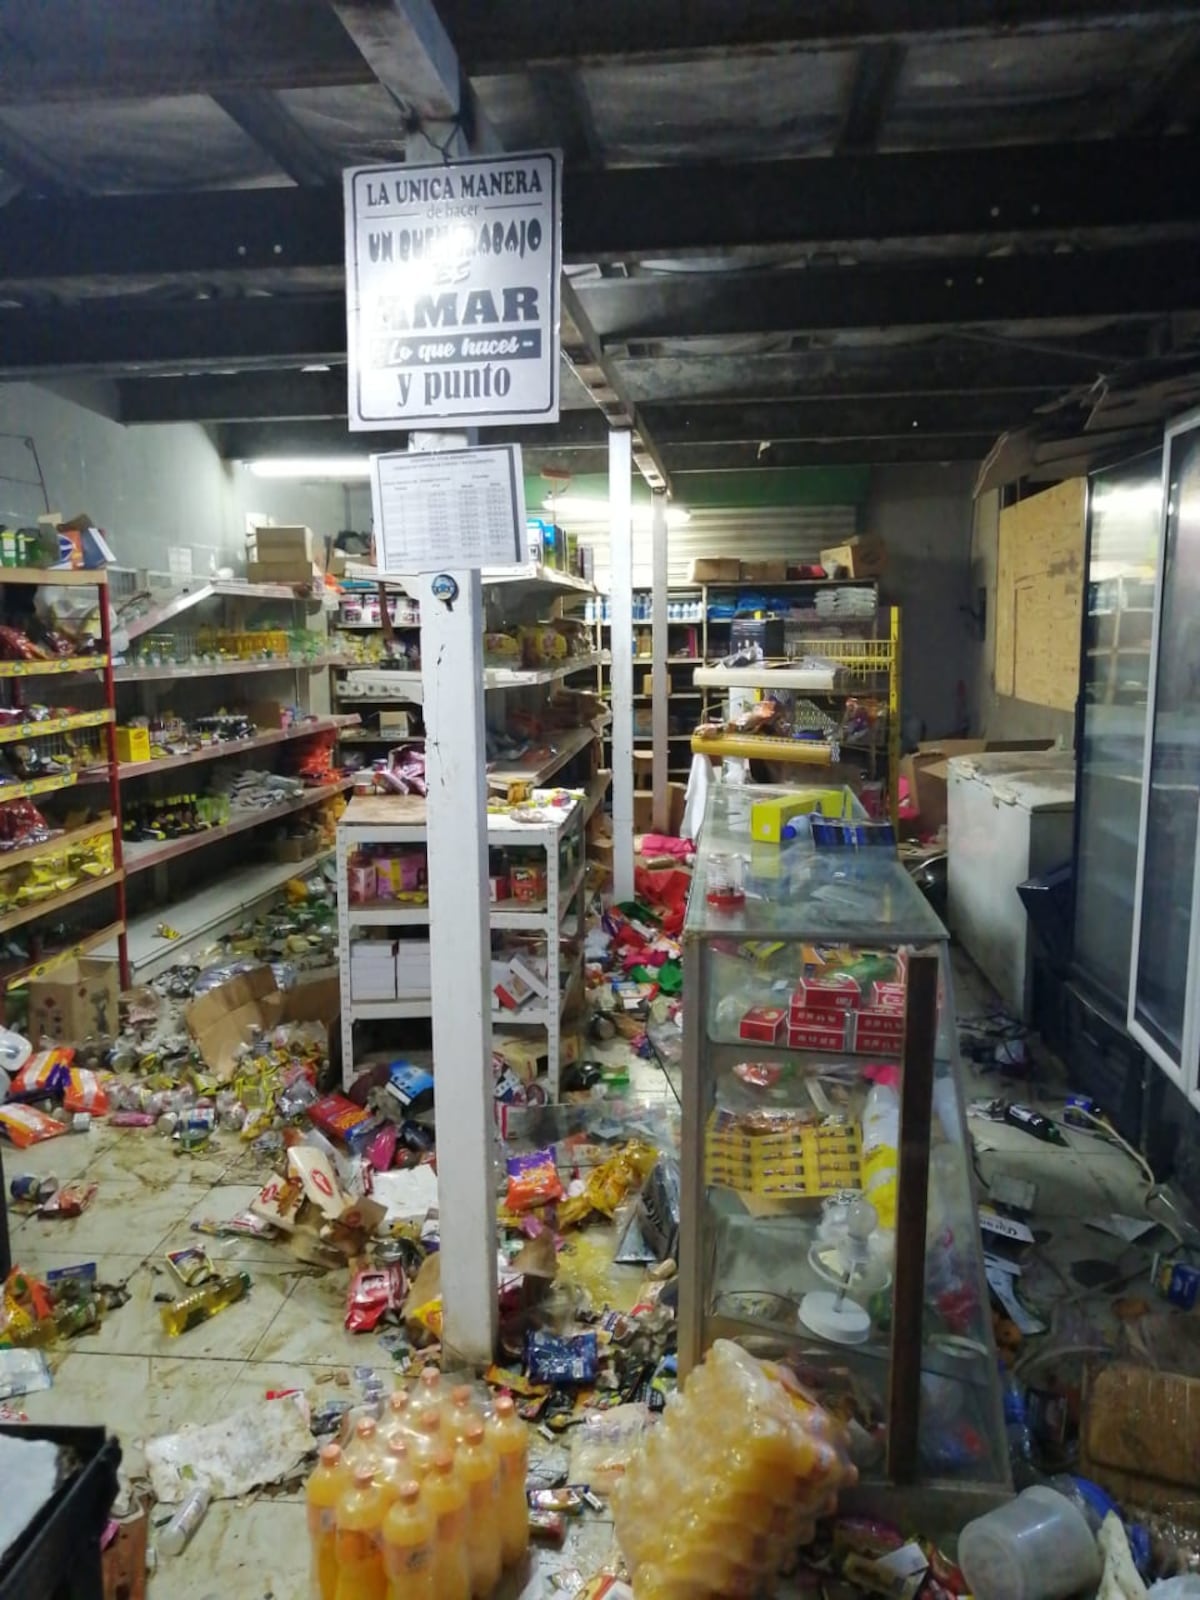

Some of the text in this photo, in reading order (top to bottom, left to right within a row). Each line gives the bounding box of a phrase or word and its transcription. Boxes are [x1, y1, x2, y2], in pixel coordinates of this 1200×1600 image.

[366, 169, 543, 207] LA UNICA MANERA
[426, 203, 480, 219] de hacer
[368, 218, 542, 263] UN BUE ABAJO
[432, 259, 471, 285] ES
[388, 340, 414, 365] Lo
[418, 345, 456, 363] que
[397, 361, 512, 408] y punto
